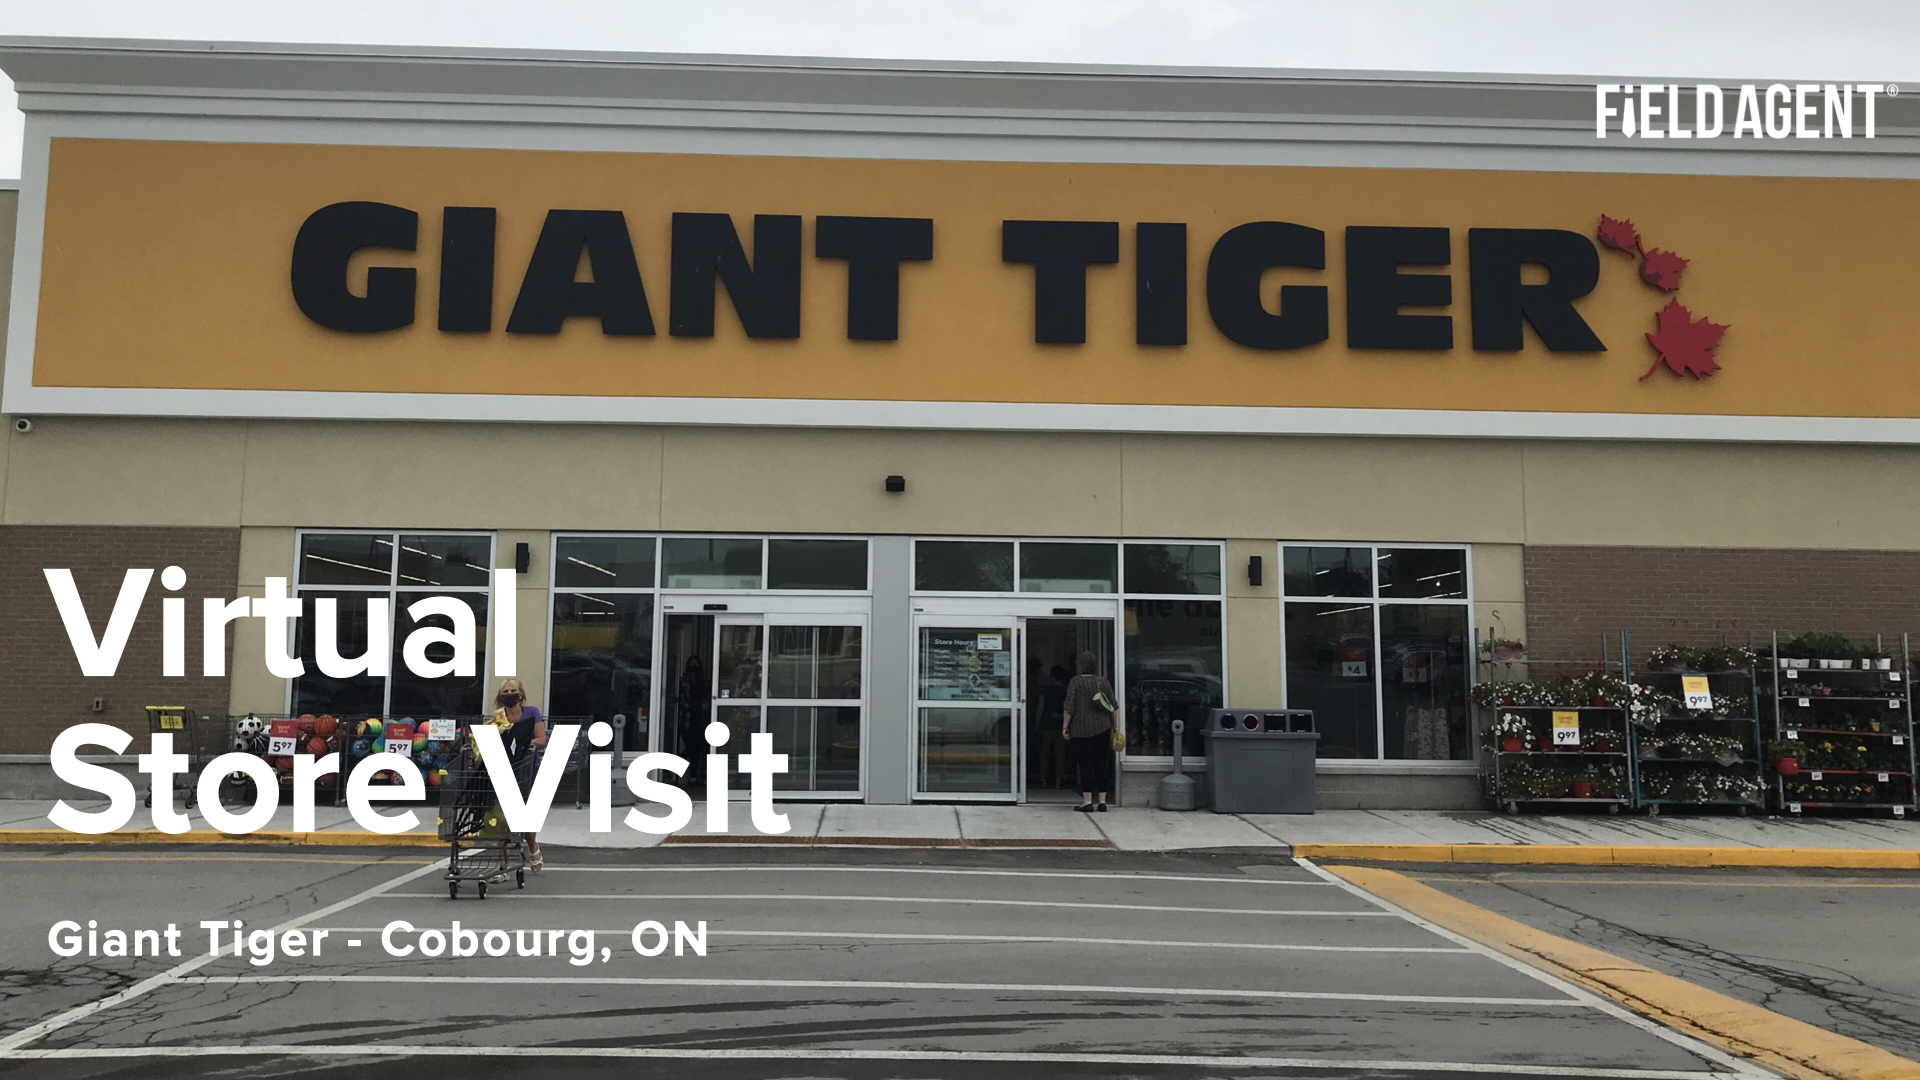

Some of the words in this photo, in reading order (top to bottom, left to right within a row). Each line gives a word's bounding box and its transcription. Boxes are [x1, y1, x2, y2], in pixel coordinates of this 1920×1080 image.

[290, 200, 934, 344] GIANT
[1001, 219, 1608, 356] TIGER
[954, 638, 974, 646] Hours
